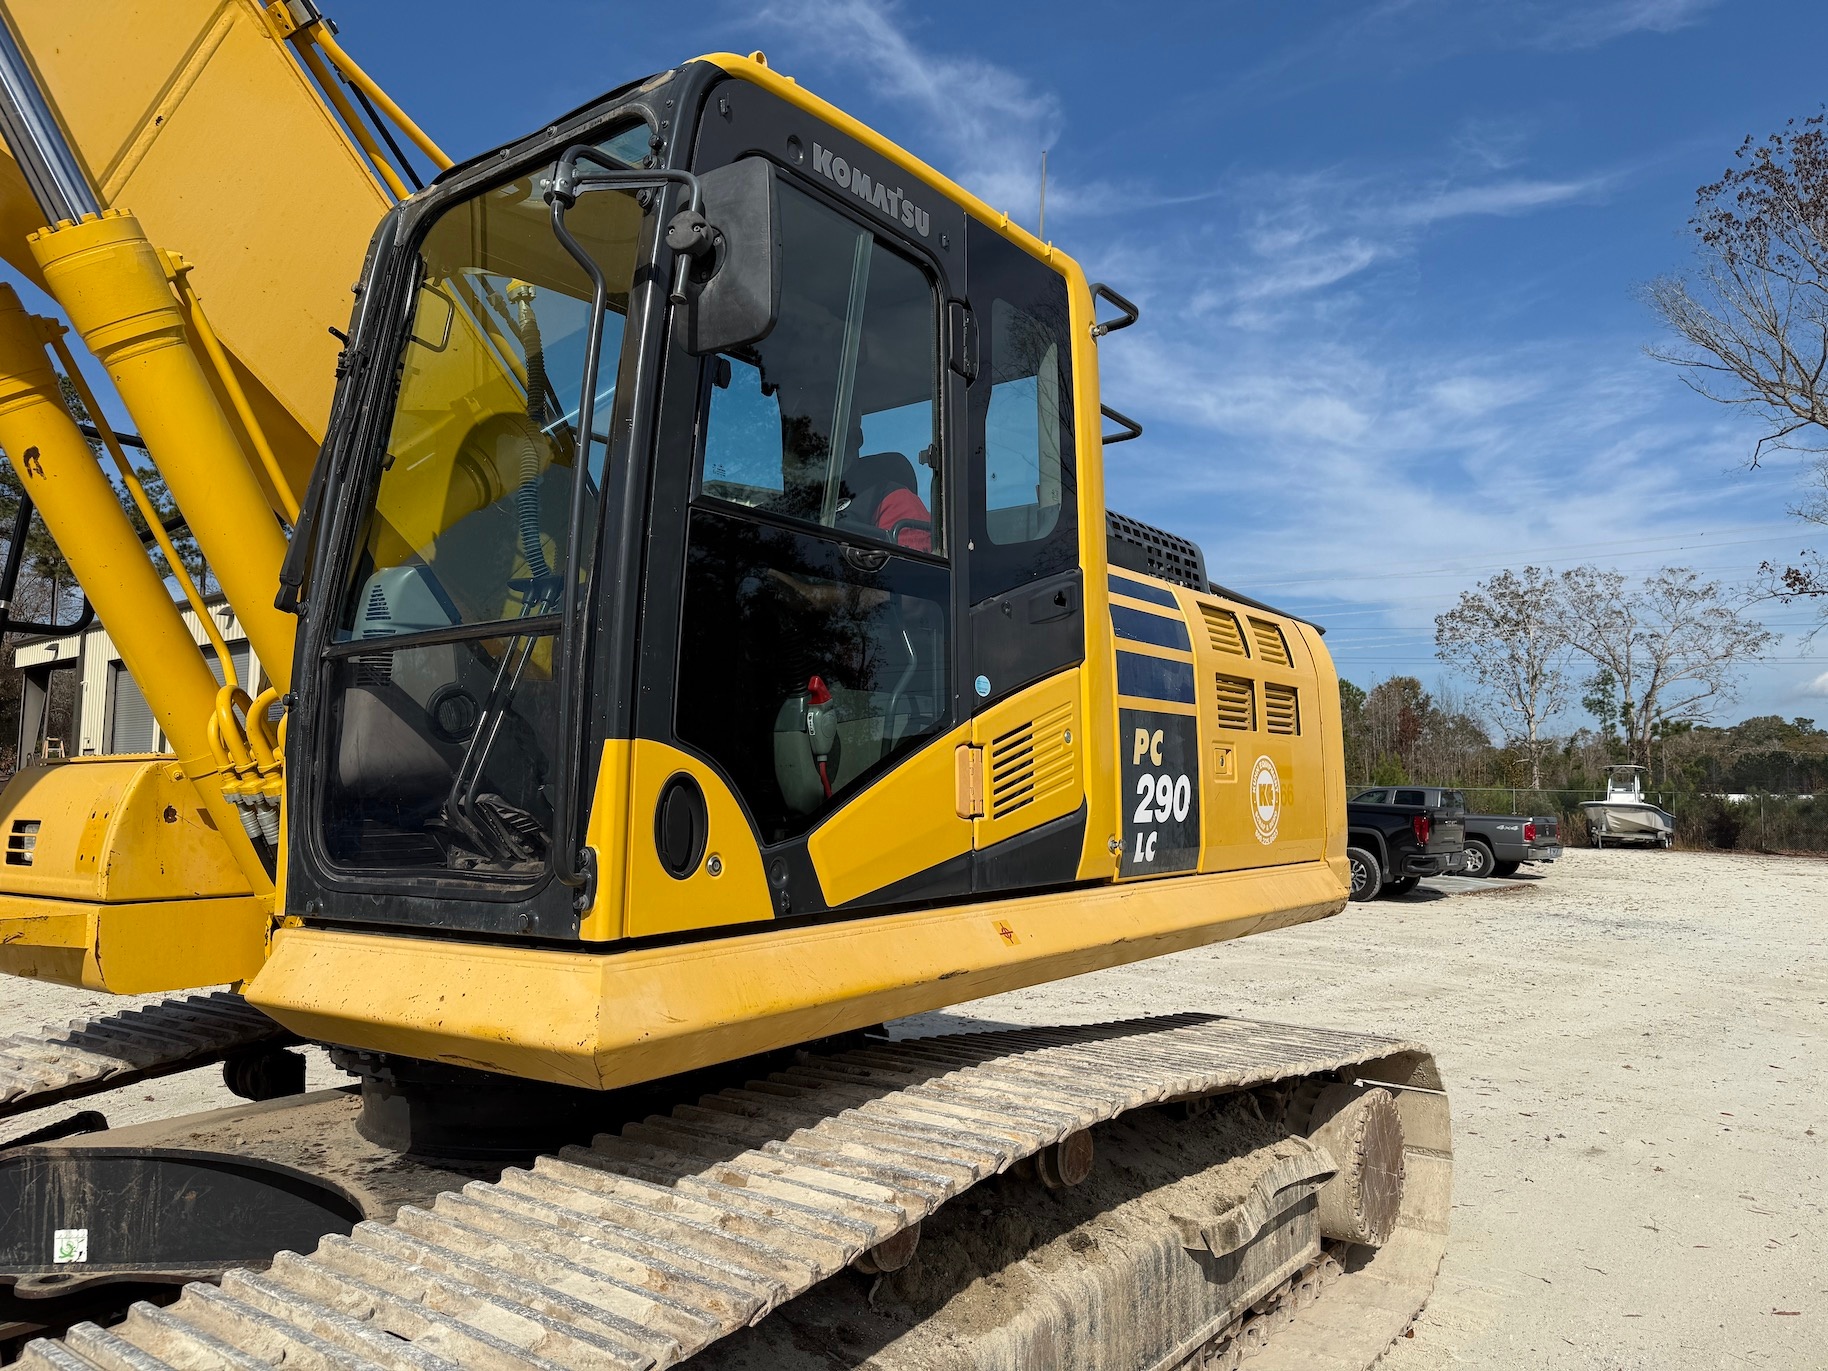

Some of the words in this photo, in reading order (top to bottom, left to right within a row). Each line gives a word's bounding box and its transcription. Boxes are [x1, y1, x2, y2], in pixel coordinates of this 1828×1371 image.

[813, 141, 930, 238] KOMATSU
[1133, 728, 1164, 766] PC
[1133, 773, 1192, 823] 290
[1133, 831, 1157, 863] LC
